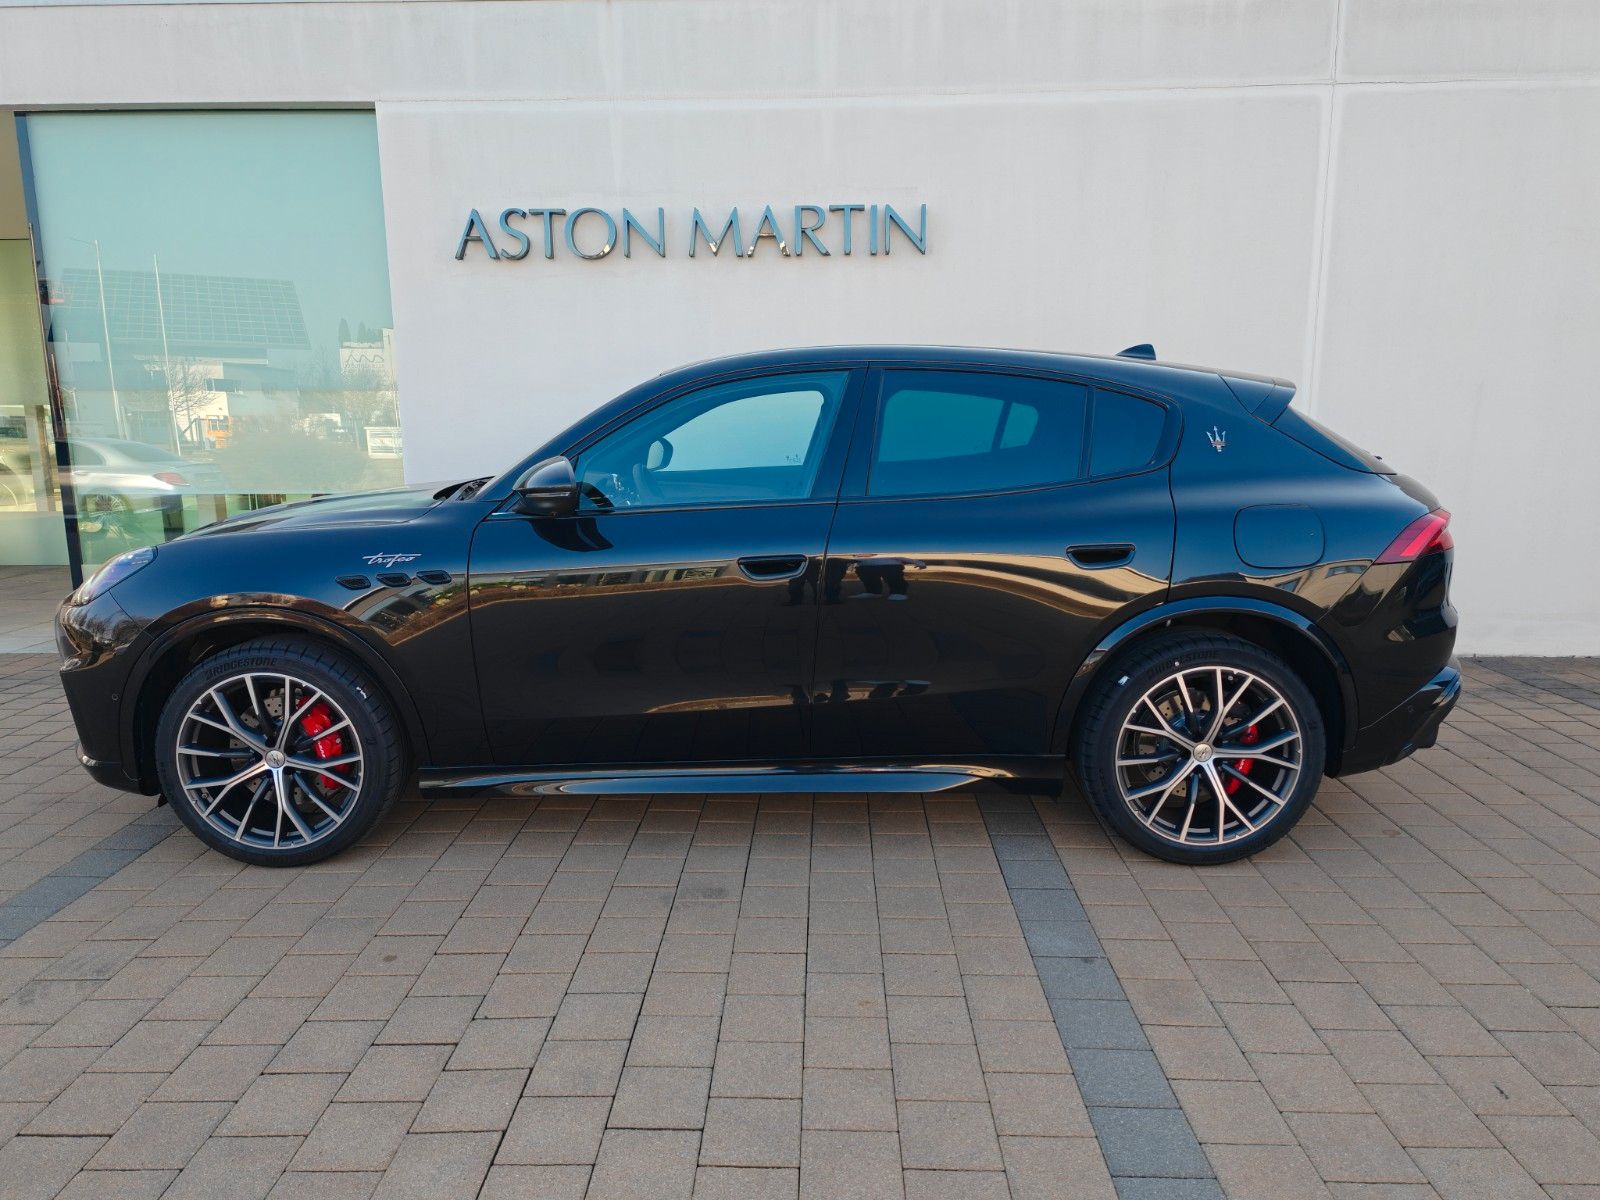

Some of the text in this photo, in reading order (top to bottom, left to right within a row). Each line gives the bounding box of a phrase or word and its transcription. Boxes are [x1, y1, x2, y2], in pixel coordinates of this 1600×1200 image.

[455, 204, 927, 261] ASTON MARTIN
[362, 552, 422, 568] trofeo
[205, 657, 278, 679] BRIDGESTONE
